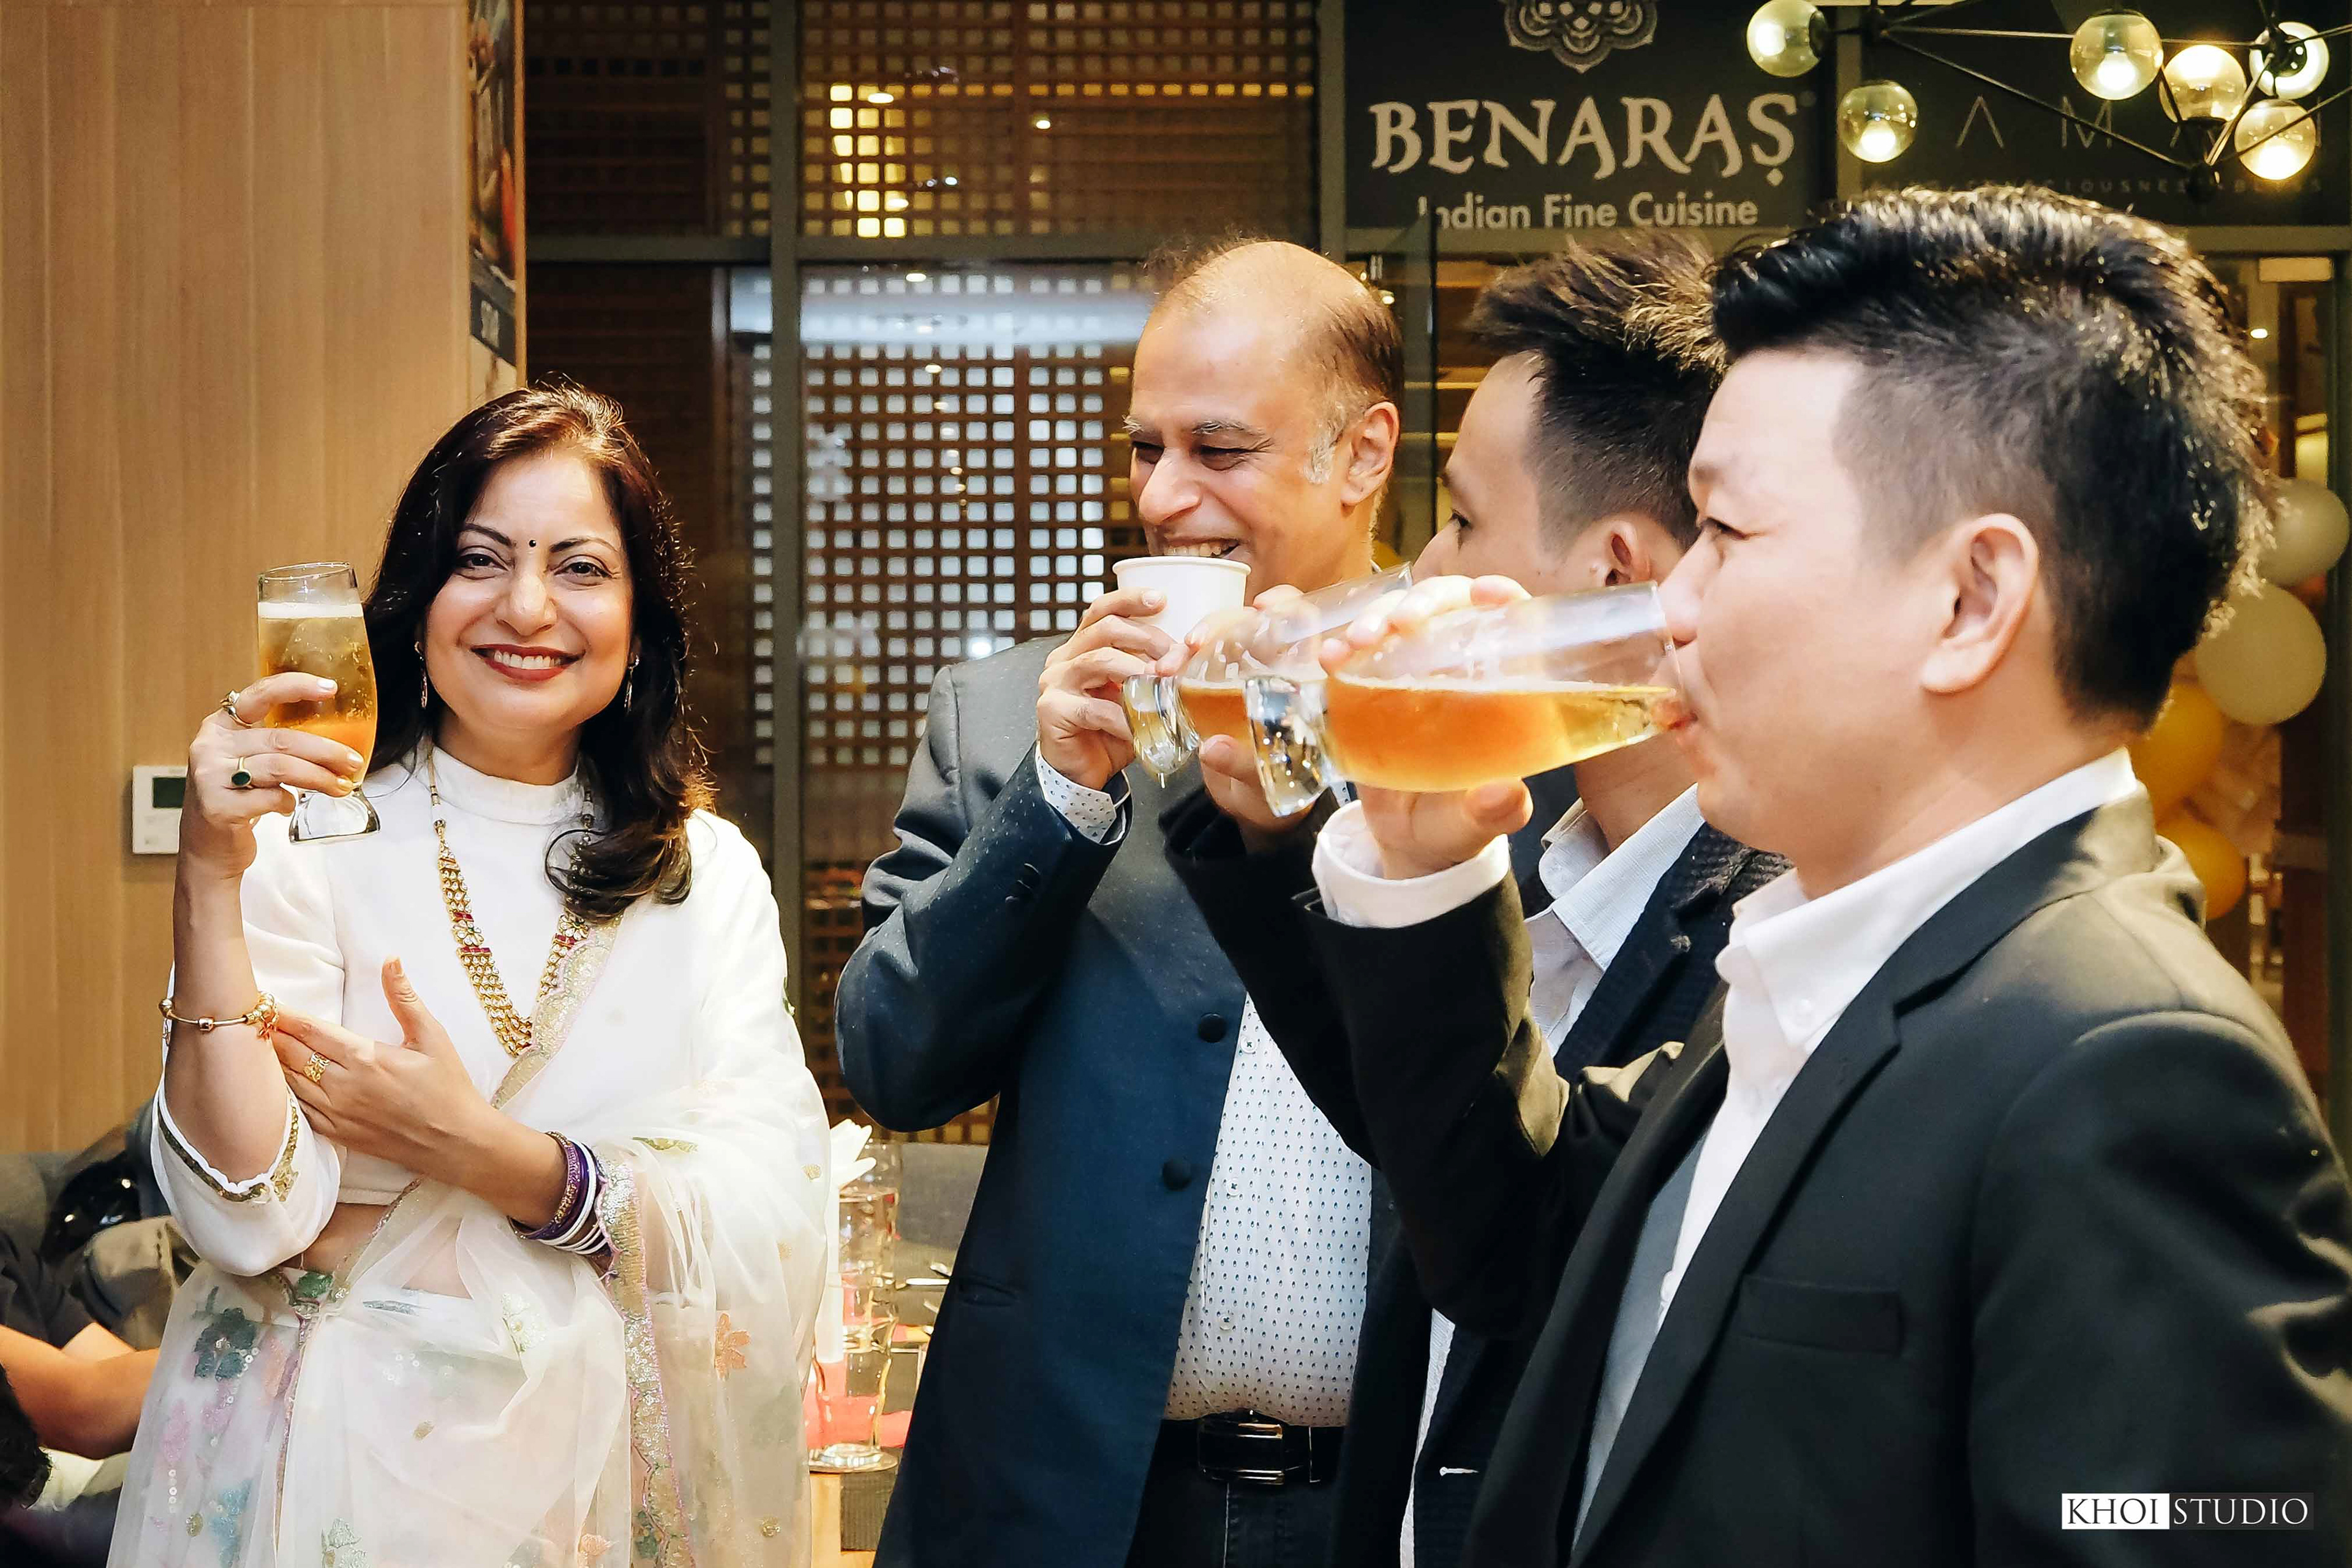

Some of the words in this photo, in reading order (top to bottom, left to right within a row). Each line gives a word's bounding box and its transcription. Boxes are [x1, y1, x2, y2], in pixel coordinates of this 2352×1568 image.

[1368, 93, 1796, 186] BENARAS
[1542, 192, 1618, 228] Fine
[1628, 190, 1758, 226] Cuisine
